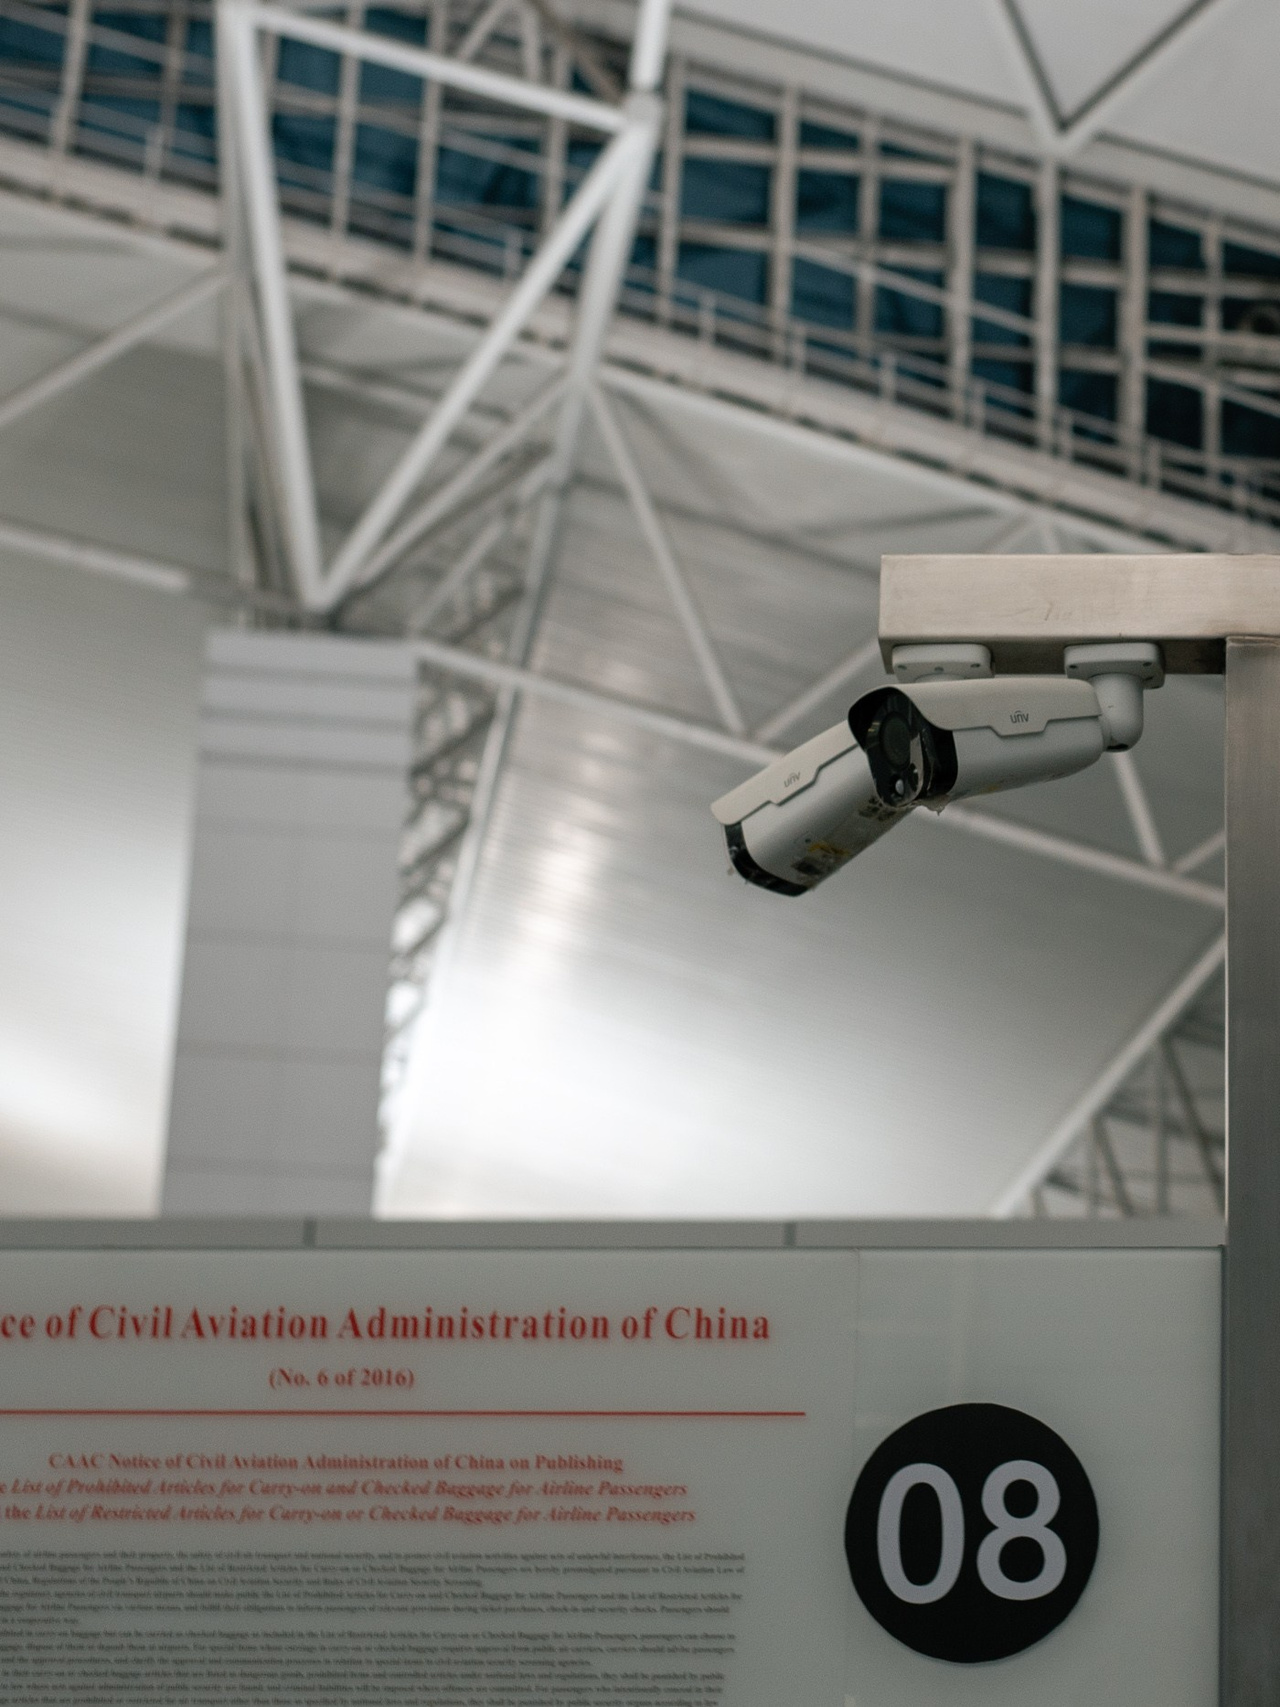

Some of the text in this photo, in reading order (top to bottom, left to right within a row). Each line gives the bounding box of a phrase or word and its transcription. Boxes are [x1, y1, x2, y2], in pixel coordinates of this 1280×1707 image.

[44, 1305, 82, 1340] of
[88, 1305, 173, 1341] Civil
[183, 1305, 328, 1341] Aviation
[338, 1306, 610, 1341] Administration
[620, 1306, 658, 1341] of
[664, 1307, 771, 1342] China
[269, 1367, 415, 1390] (No. 6 of 2016)
[48, 1454, 622, 1476] CAAC Notice of Civil Aviation Administration of China on Publishing
[11, 1479, 42, 1495] List
[46, 1479, 63, 1499] of
[67, 1479, 151, 1495] Prohibited
[155, 1480, 216, 1495] Articles
[220, 1480, 245, 1500] for
[248, 1480, 322, 1500] Carry-on
[326, 1480, 357, 1495] and
[361, 1480, 431, 1496] Checked
[435, 1480, 505, 1500] Baggage
[509, 1480, 534, 1500] for
[538, 1481, 594, 1496] Airline
[598, 1481, 688, 1501] Passengers
[5, 1504, 696, 1526] the List of Restricted Articles for Carry-on or Checked Baggage for Airline Passengers
[877, 1459, 1067, 1604] 08
